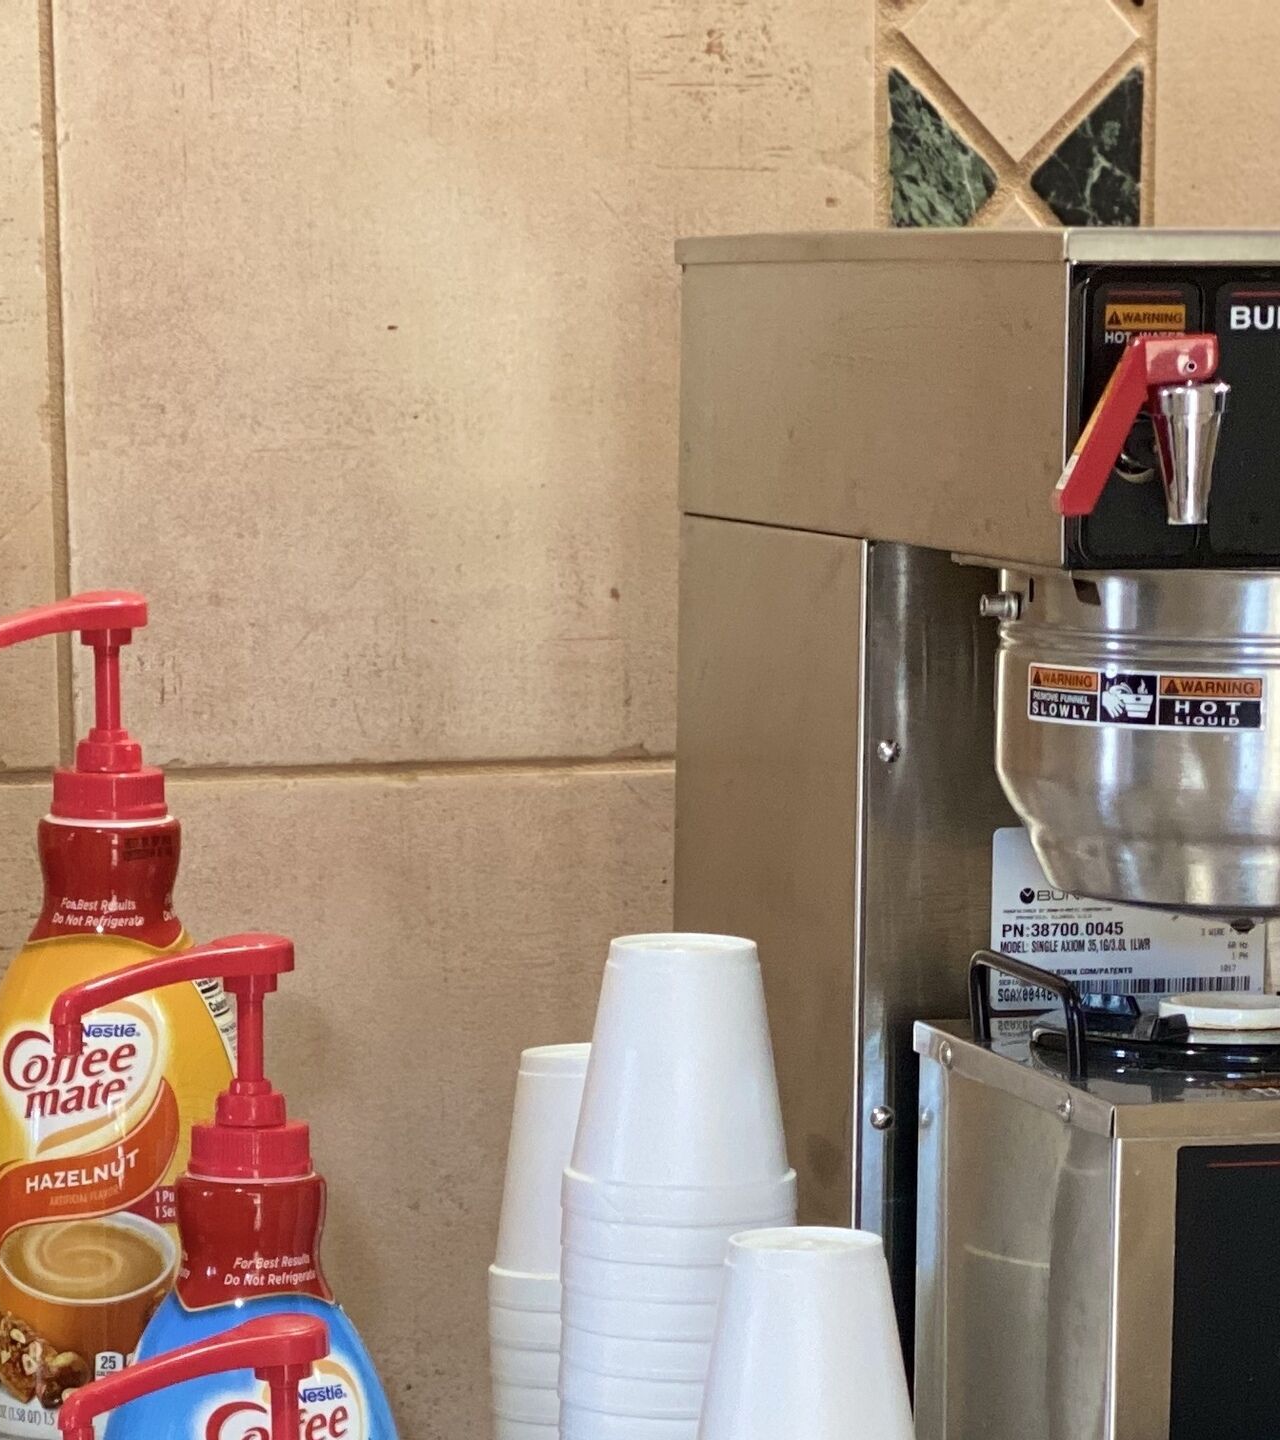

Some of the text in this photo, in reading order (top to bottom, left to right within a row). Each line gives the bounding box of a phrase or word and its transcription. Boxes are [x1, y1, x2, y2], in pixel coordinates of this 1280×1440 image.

[1122, 311, 1183, 325] WARNING
[1041, 671, 1093, 688] WARNING
[1180, 679, 1255, 695] WARNING
[1032, 701, 1090, 719] SLOWLY
[1174, 700, 1241, 715] HOT
[1174, 716, 1240, 726] LIQUID
[76, 898, 98, 911] Best
[65, 914, 84, 926] Not
[3, 1030, 137, 1092] Coffee
[24, 1079, 125, 1119] mate
[25, 1149, 139, 1194] HAZELNUT
[233, 1256, 279, 1270] For Best
[224, 1273, 265, 1286] Do Not
[101, 1355, 117, 1370] 25
